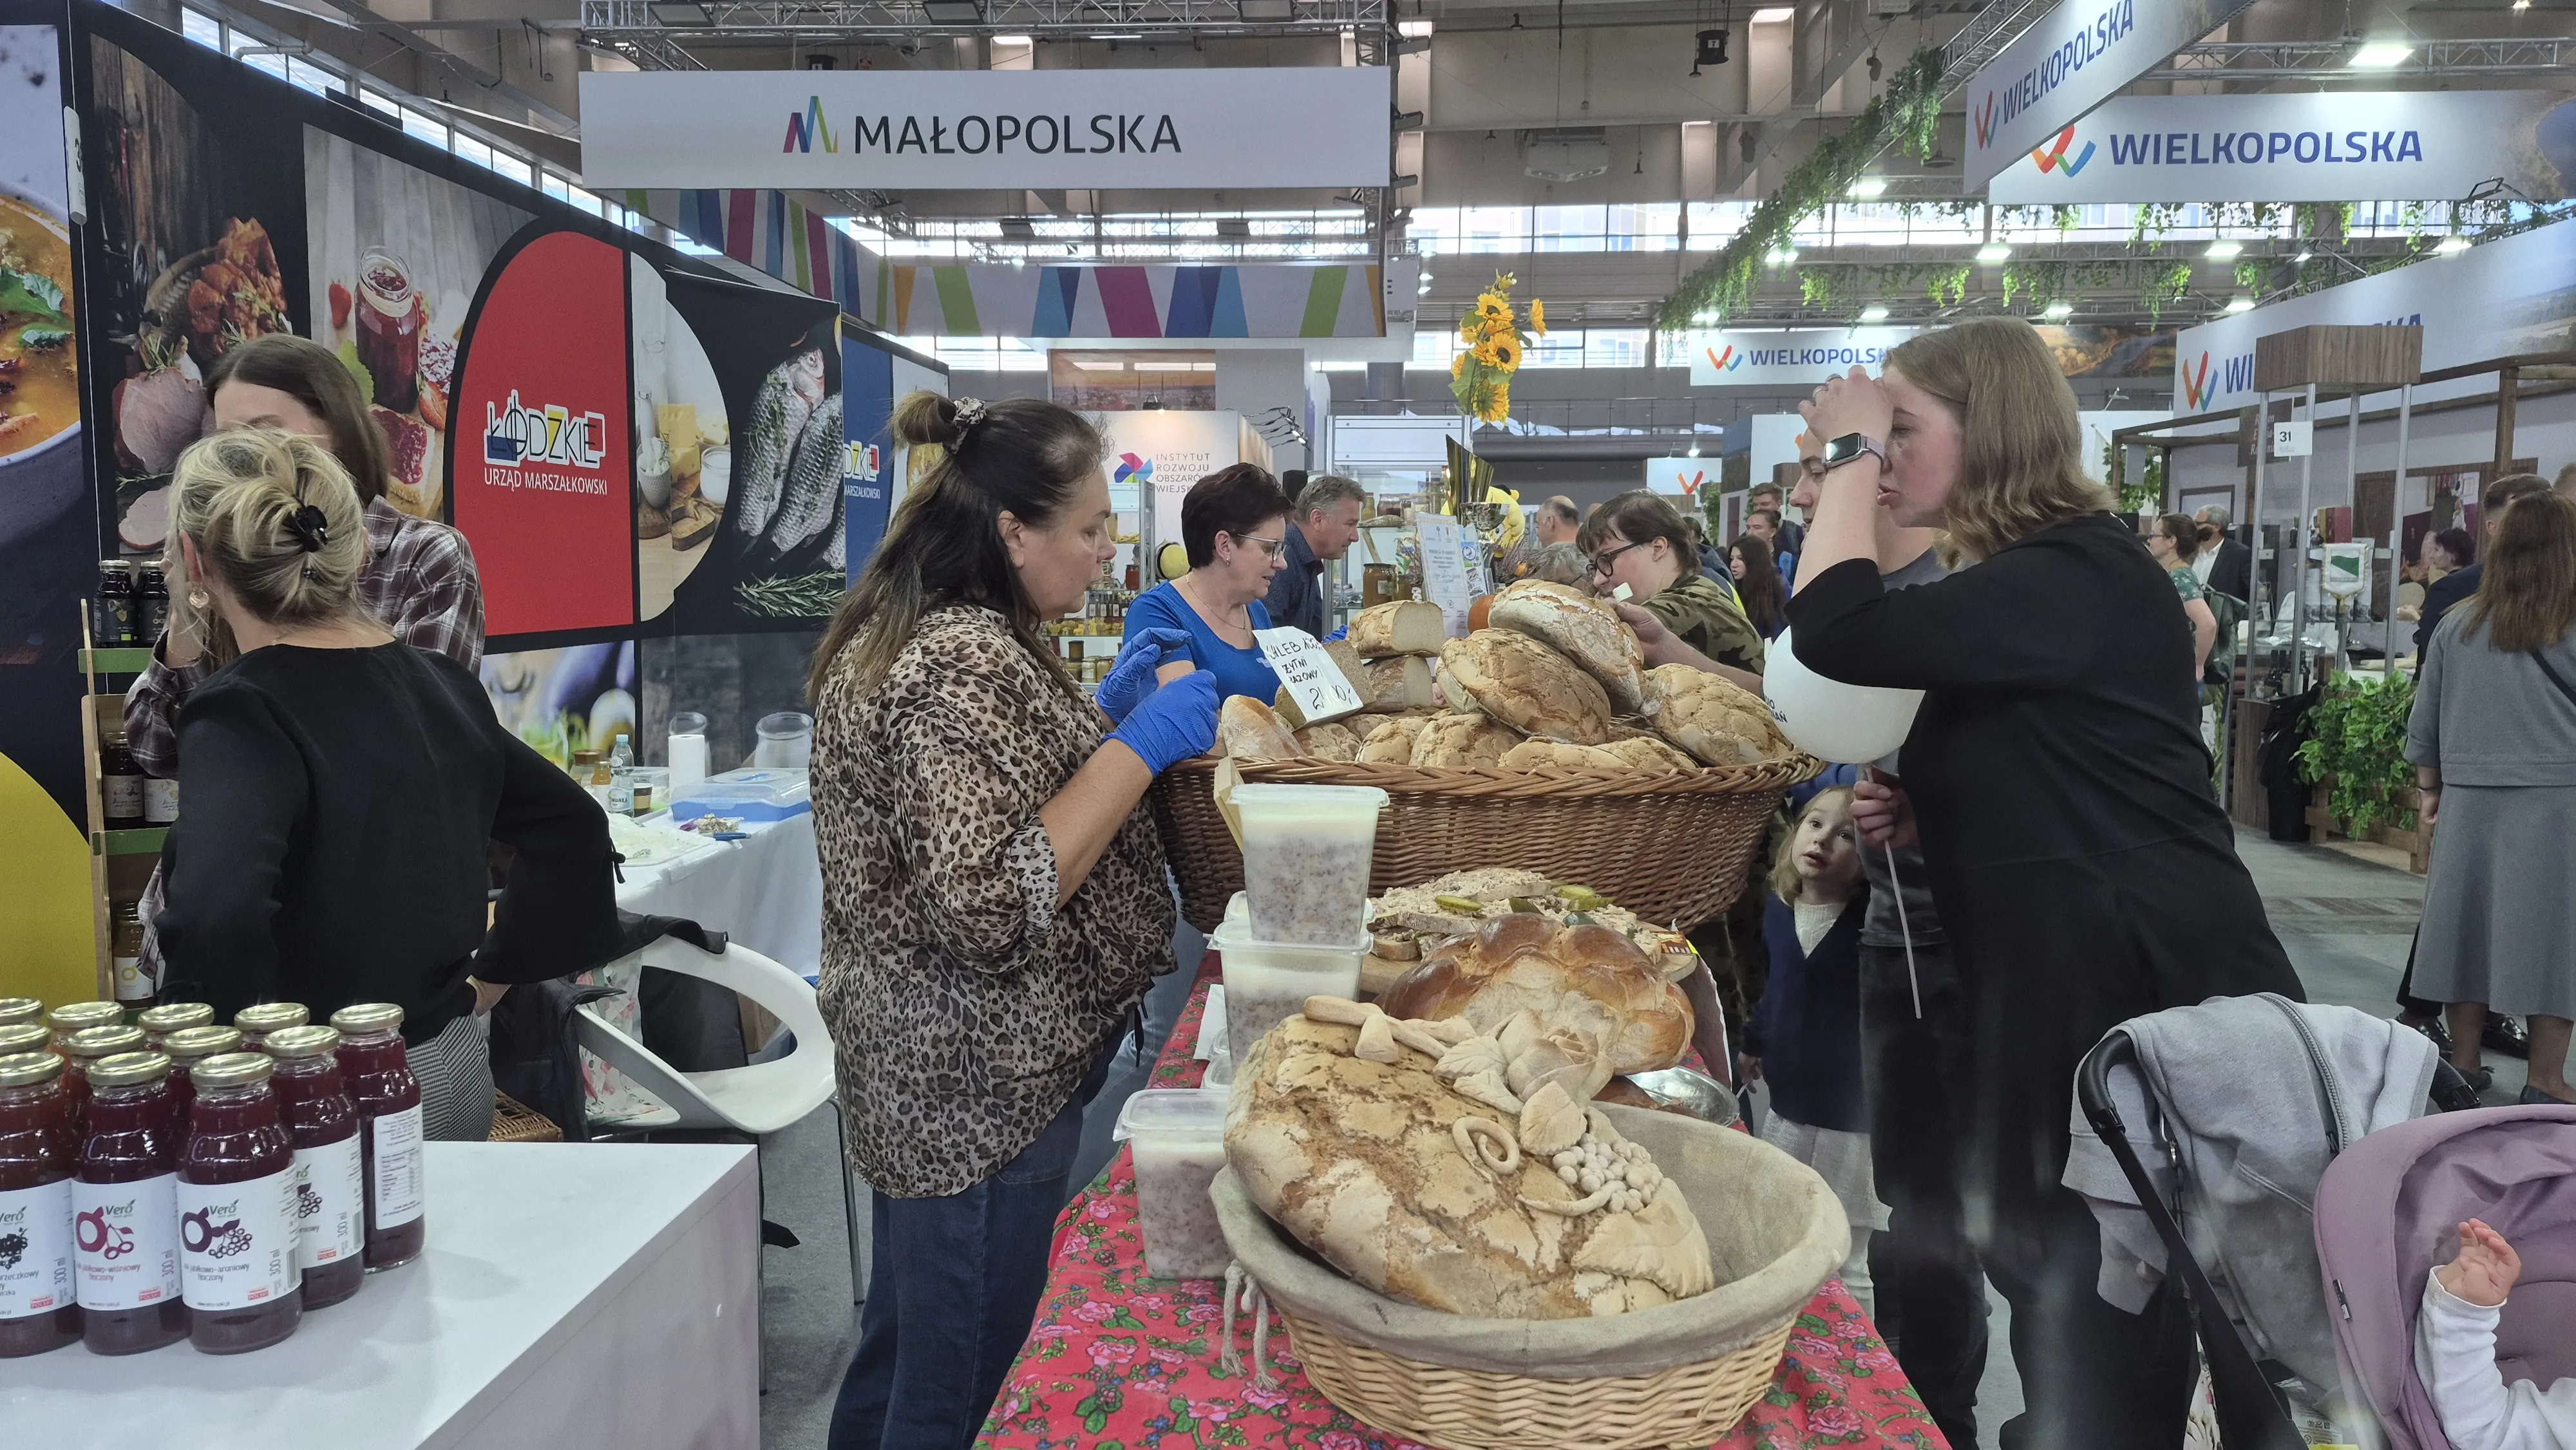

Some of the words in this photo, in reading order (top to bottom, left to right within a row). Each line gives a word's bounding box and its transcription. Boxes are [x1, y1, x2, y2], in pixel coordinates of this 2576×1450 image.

[2003, 0, 2134, 125] WIELKOPOLSKA
[855, 114, 1182, 155] MAŁOPOLSKA
[2109, 130, 2423, 165] WIELKOPOLSKA
[1750, 347, 1886, 366] WIELKOPOLSK
[2279, 431, 2291, 442] 31
[844, 443, 878, 480] DZKIE
[1156, 453, 1210, 461] INSTYTUT
[1156, 464, 1209, 472] ROZWOJU
[484, 467, 522, 492] URZĄD
[525, 471, 607, 495] MARSZAŁKOWSKI
[53, 1257, 66, 1266] ml
[161, 1260, 174, 1277] 300
[269, 1259, 281, 1276] 300
[0, 1270, 39, 1281] rzeczkowy
[53, 1267, 67, 1285] 300
